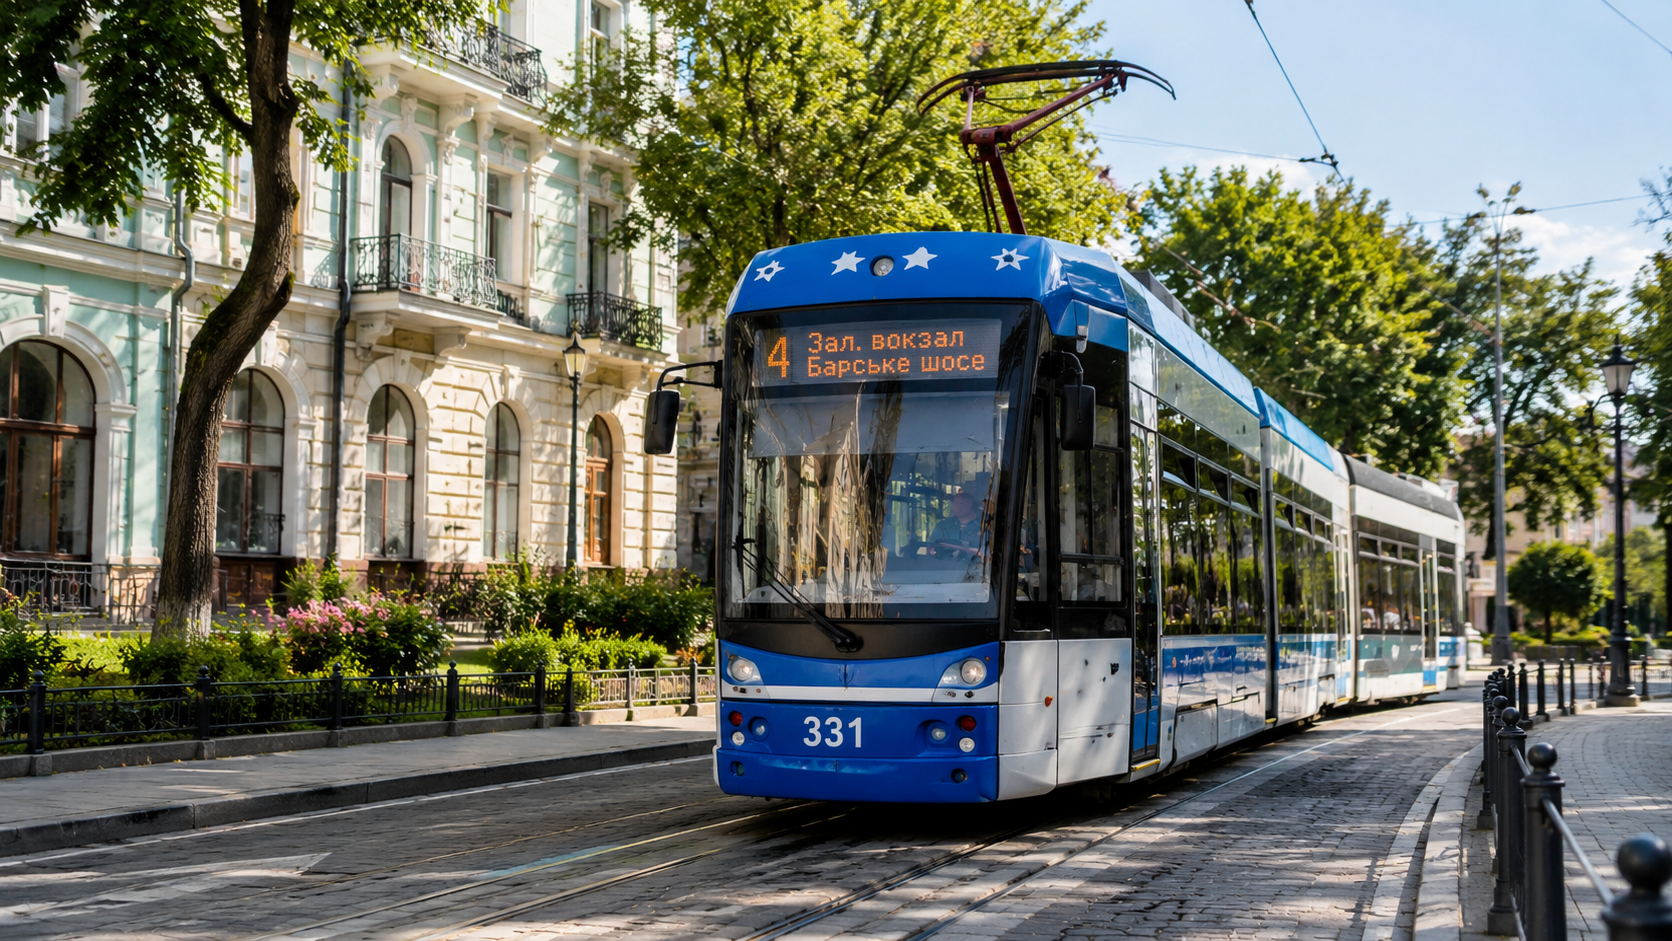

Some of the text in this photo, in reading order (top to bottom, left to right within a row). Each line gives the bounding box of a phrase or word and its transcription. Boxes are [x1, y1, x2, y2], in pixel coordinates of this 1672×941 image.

[808, 330, 964, 353] Зал. вокзал
[767, 337, 790, 378] 4
[807, 354, 985, 378] Барське шосе
[803, 716, 862, 748] 331
